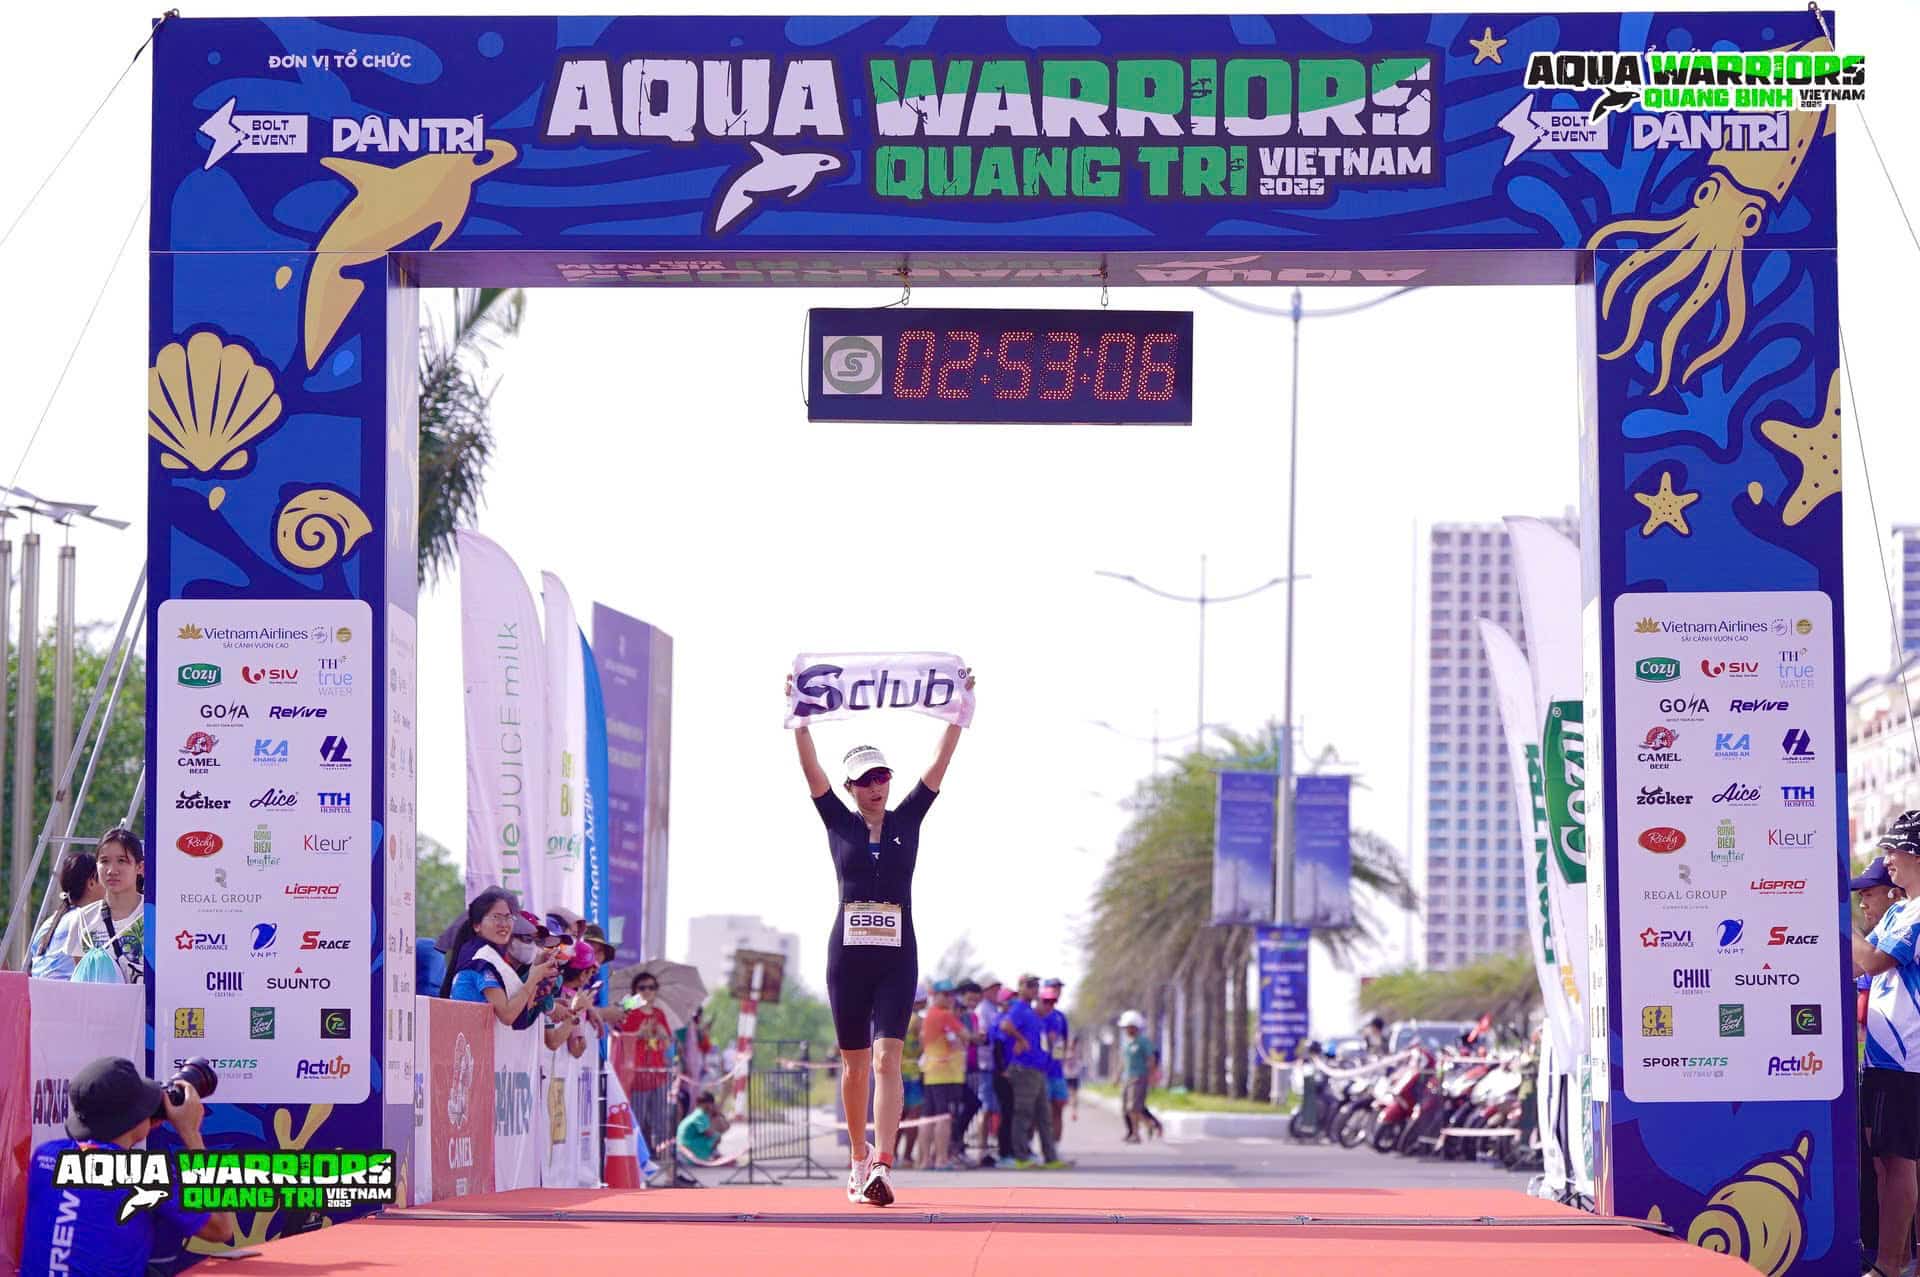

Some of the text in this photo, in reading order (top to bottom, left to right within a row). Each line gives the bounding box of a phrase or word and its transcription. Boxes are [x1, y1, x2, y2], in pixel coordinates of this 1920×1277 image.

[268, 48, 412, 72] ĐƠN VỊ TỔ CHỨC
[546, 57, 1432, 142] AQUA WARRIORS
[251, 120, 289, 132] BOLT
[1551, 116, 1589, 127] BOLT
[251, 134, 298, 146] EVENT
[1551, 131, 1598, 143] EVENT
[876, 145, 1432, 200] QUANG TRI VIETNAM
[1259, 178, 1325, 197] 2025
[892, 329, 1178, 401] 02:53:06
[204, 627, 258, 640] Vietnam
[259, 627, 308, 640] Airlines
[1661, 620, 1717, 634] Vietnam
[1718, 620, 1768, 633] Airlines
[497, 621, 519, 697] milk
[1779, 651, 1798, 662] TH
[318, 658, 337, 669] TH
[1640, 661, 1676, 678] Cozy
[1728, 662, 1759, 672] SIV
[182, 666, 217, 683] Cozy
[269, 669, 299, 679] SIV
[1778, 665, 1814, 678] true
[318, 672, 352, 686] true
[254, 739, 288, 756] KA
[1716, 733, 1750, 750] KA
[178, 758, 221, 767] CAMEL
[499, 705, 523, 816] JUICE
[1638, 753, 1682, 762] CAMEL
[249, 788, 298, 809] Aice
[317, 793, 350, 805] TTH
[1712, 782, 1761, 804] Aice
[1781, 786, 1815, 799] TTH
[304, 834, 348, 852] Kleur
[1768, 829, 1813, 846] Kleur
[180, 894, 262, 904] REGAL GROUP
[1644, 890, 1728, 900] REGAL GROUP
[850, 914, 896, 927] 6386
[195, 934, 226, 944] PVI
[1660, 931, 1692, 941] PVI
[267, 978, 331, 990] SUUNTO
[1735, 974, 1800, 986] SUUNTO
[175, 1030, 205, 1038] RACE
[1642, 1028, 1673, 1036] RACE
[50, 1190, 81, 1277] REW
